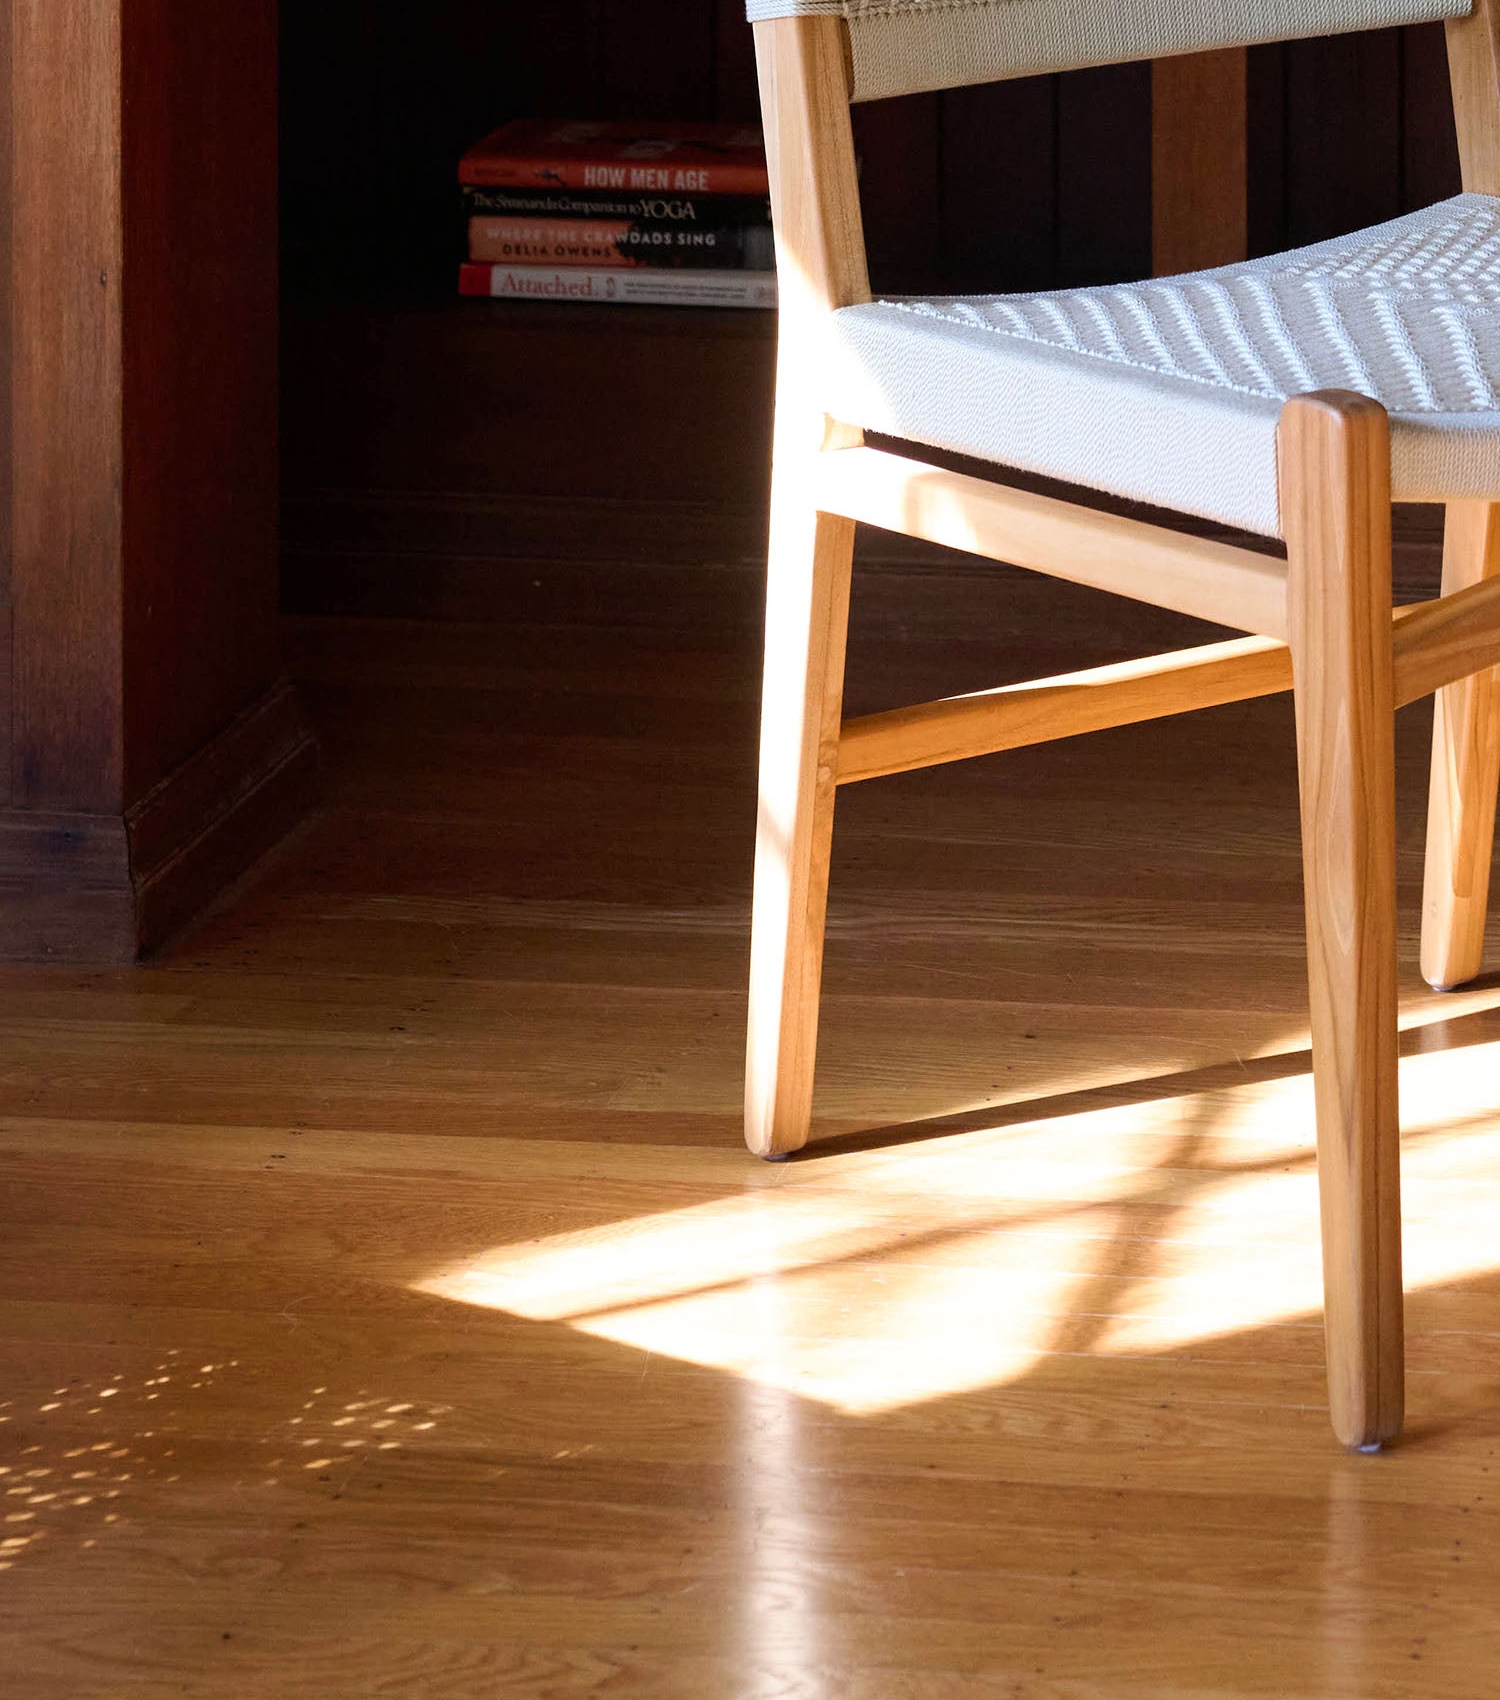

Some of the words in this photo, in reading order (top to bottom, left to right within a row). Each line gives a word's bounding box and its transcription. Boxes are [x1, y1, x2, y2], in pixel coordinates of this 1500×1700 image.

[584, 165, 626, 189] HOW
[630, 167, 669, 190] MEN
[674, 168, 709, 192] AGE
[472, 191, 495, 207] The
[640, 198, 697, 221] YOGA
[486, 228, 541, 242] WHERE
[549, 229, 577, 243] THE
[584, 230, 673, 247] CRAWDADS
[677, 232, 717, 248] SING
[501, 243, 548, 256] DELIA
[553, 246, 611, 258] OWENS
[500, 273, 600, 298] Attached.
